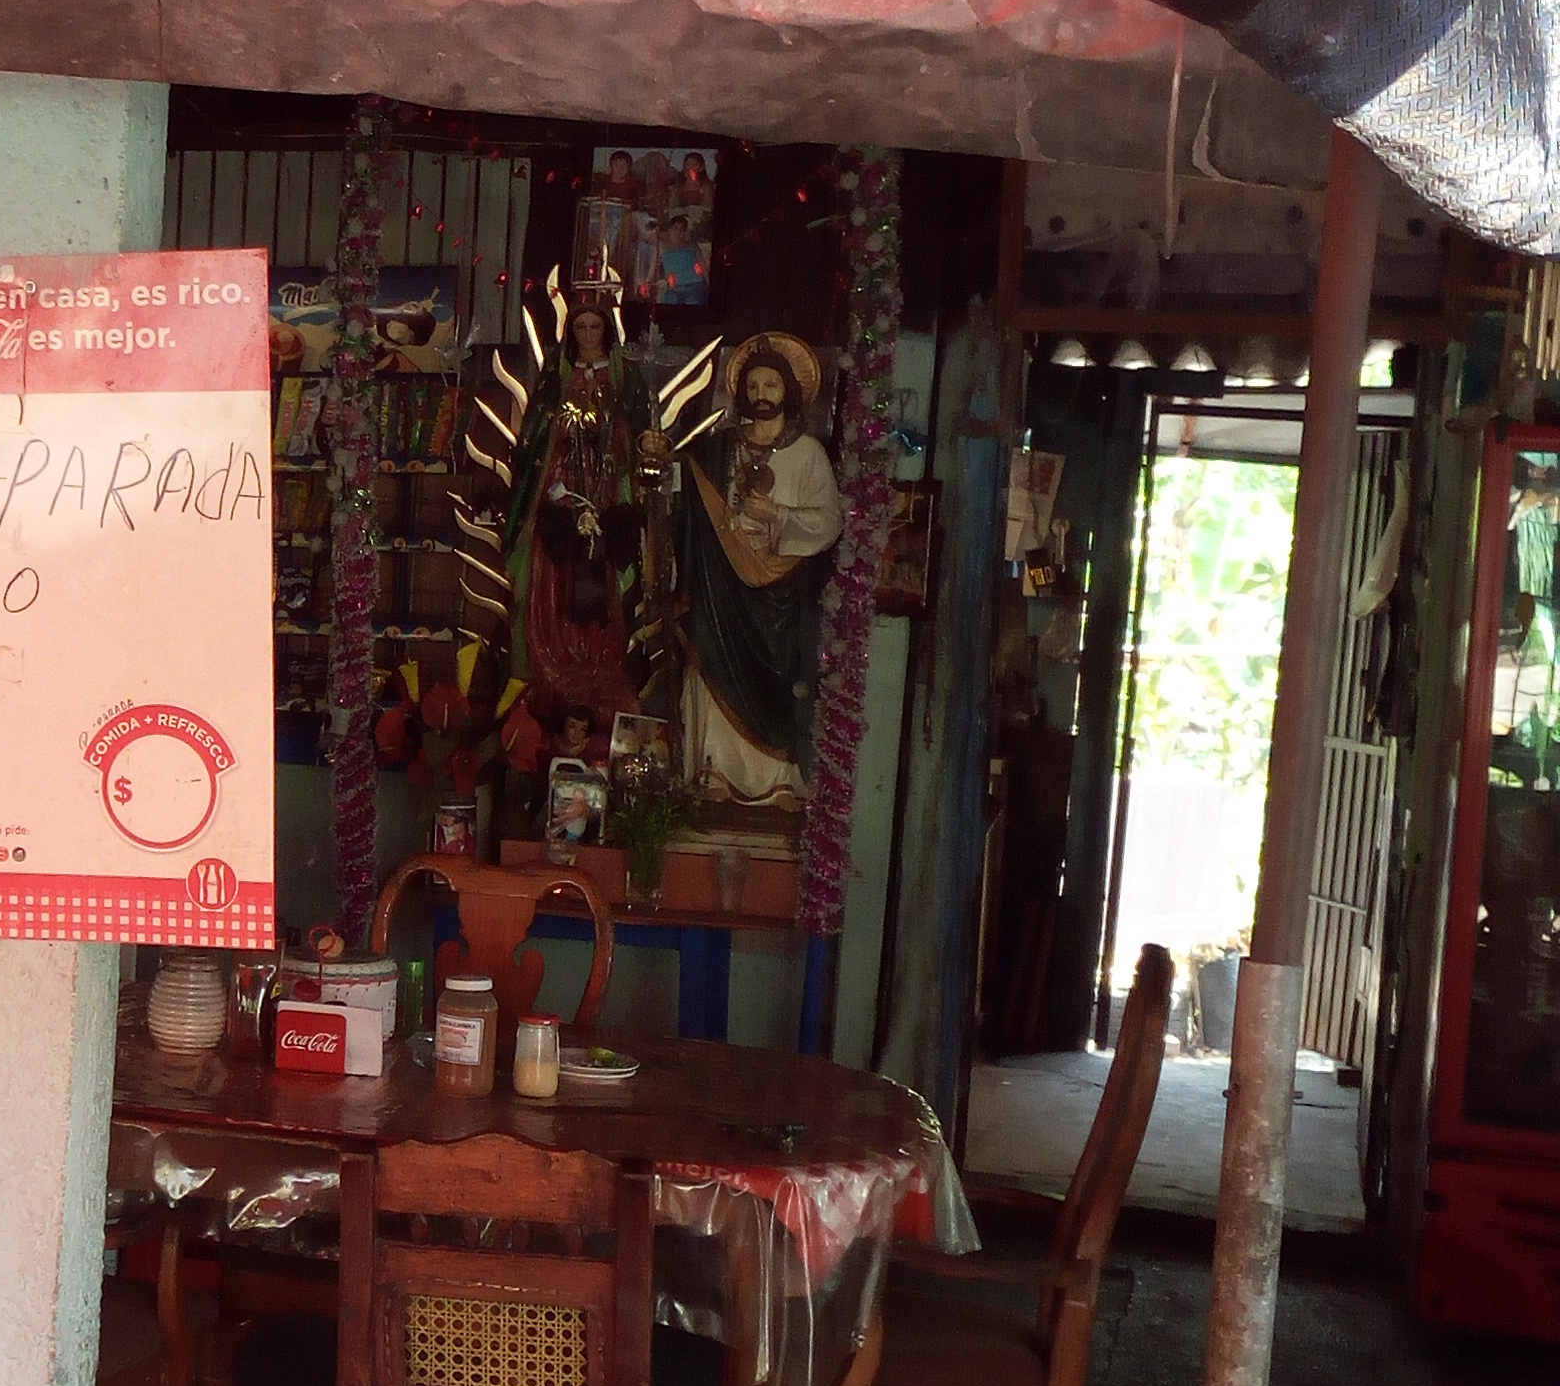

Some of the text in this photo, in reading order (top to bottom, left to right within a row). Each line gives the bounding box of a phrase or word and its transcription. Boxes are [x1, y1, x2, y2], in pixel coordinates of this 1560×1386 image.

[39, 286, 120, 312] casa,
[131, 284, 167, 306] es
[178, 278, 251, 305] rico.
[28, 328, 63, 350] es
[75, 321, 176, 354] mejor.
[90, 717, 140, 766] COMIDA
[157, 713, 228, 769] REFRESCO
[113, 775, 133, 806] $
[280, 1029, 341, 1054] Coca-Cola
